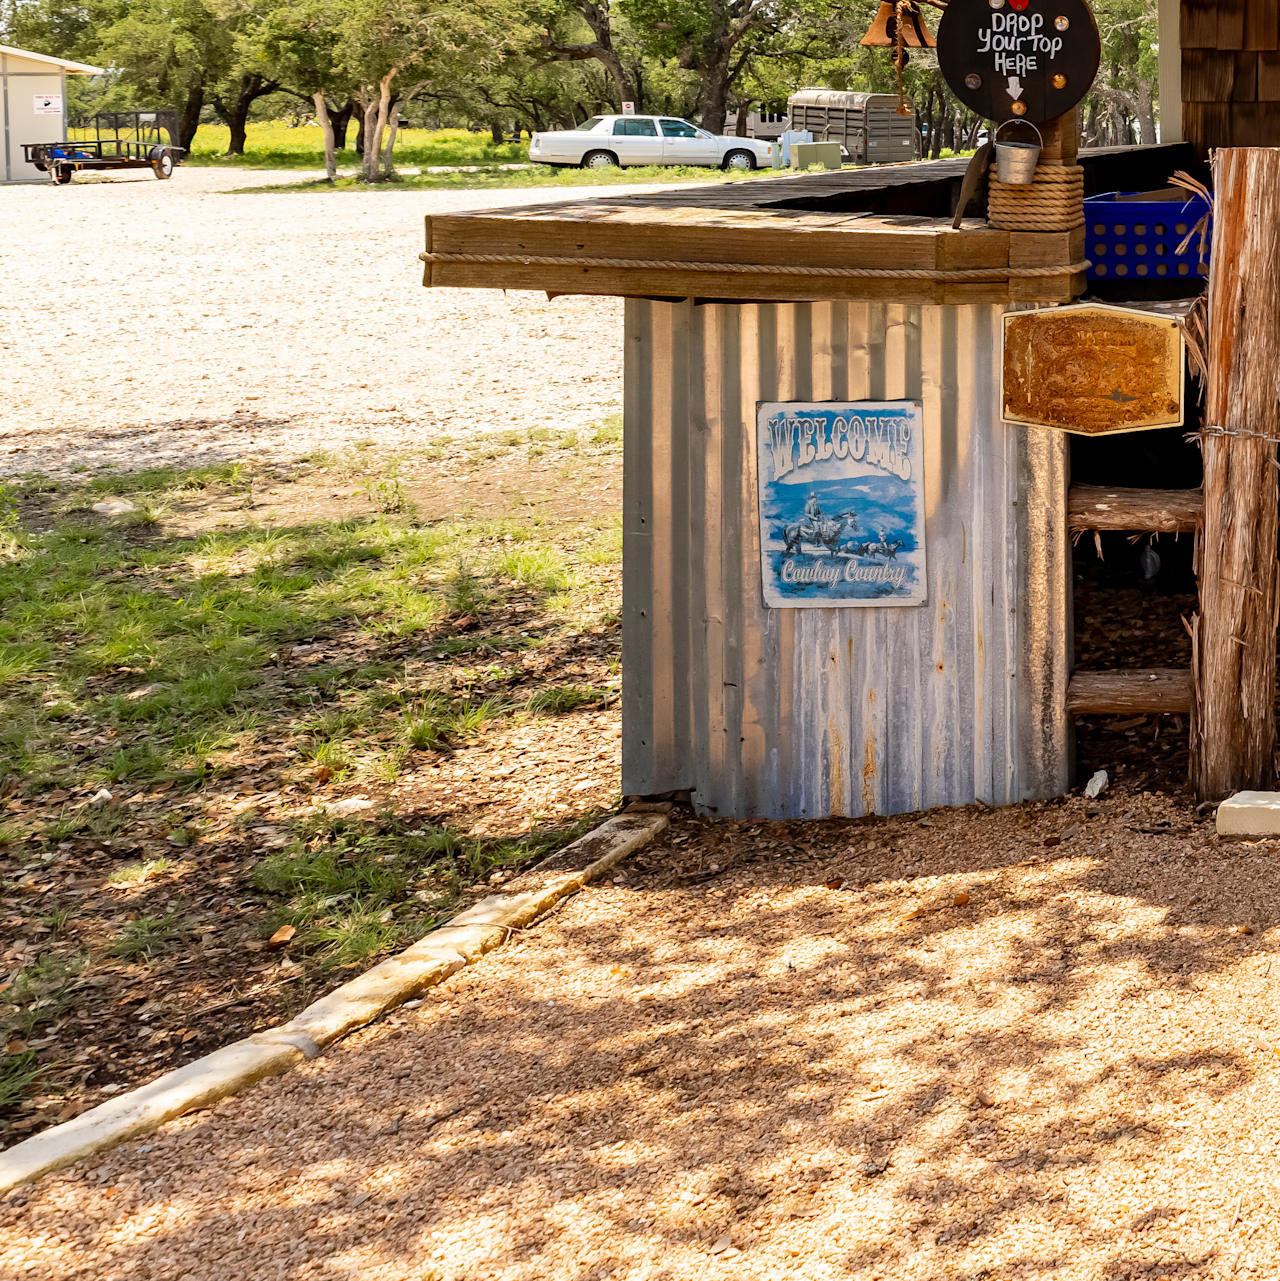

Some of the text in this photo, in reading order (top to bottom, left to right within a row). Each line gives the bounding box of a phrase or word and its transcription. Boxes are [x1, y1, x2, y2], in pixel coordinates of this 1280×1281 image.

[991, 13, 1043, 36] DROP
[767, 415, 912, 482] WELCOME
[781, 558, 907, 589] Cowboy Country
